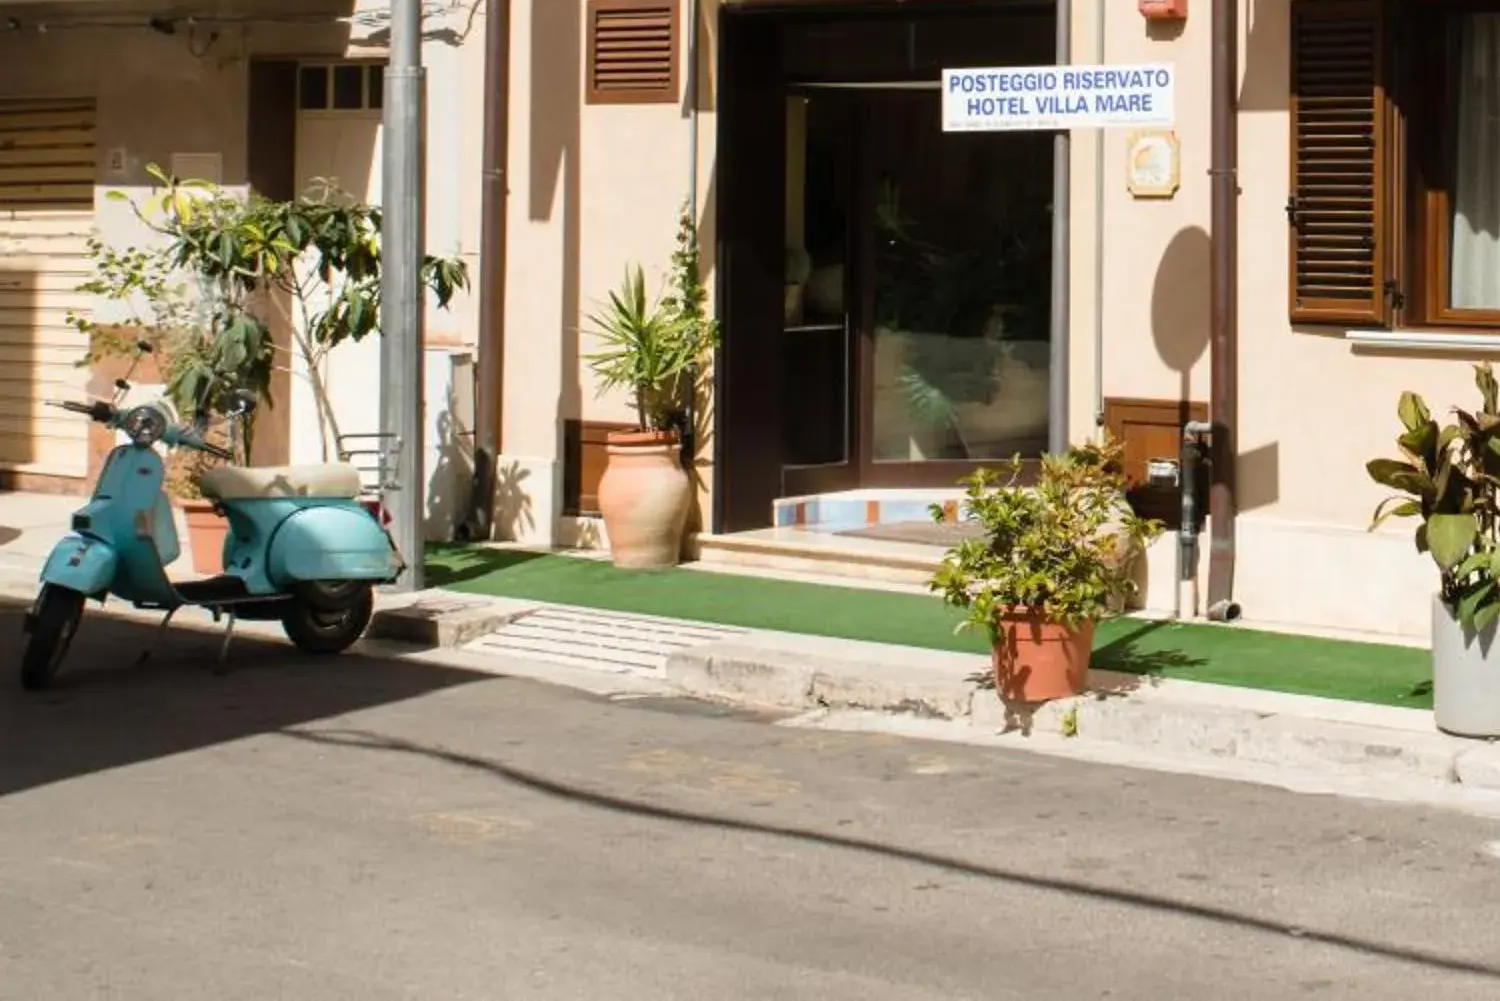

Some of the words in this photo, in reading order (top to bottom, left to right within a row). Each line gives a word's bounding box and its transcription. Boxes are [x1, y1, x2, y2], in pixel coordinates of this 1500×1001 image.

[950, 73, 1057, 93] POSTEGGIO
[1063, 69, 1170, 90] RISERVATO
[967, 97, 1030, 116] HOTEL
[1035, 95, 1089, 114] VILLA
[1095, 93, 1153, 113] MARE
